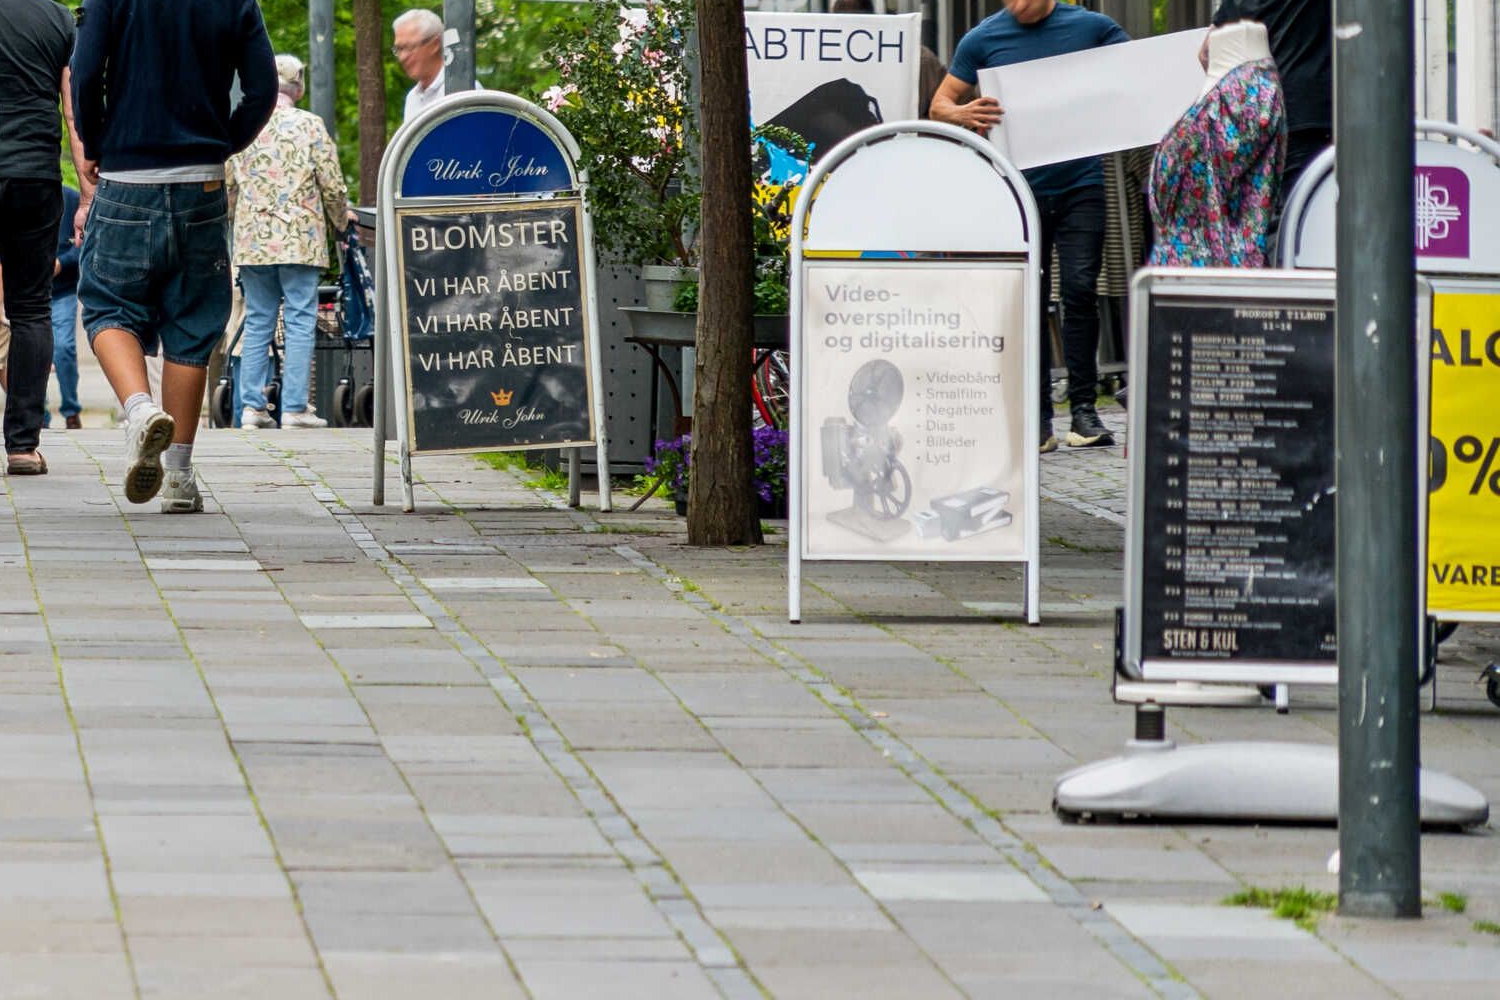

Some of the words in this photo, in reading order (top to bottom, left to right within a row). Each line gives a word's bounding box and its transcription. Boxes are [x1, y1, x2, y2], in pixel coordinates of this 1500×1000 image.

[426, 157, 484, 181] Ulrik
[488, 154, 550, 187] John
[410, 220, 570, 252] BLOMSTER
[414, 278, 437, 298] VI
[444, 275, 491, 296] HAR
[497, 269, 573, 293] ÅBENT
[825, 283, 901, 302] Video-
[416, 315, 439, 335] VI
[446, 312, 492, 333] HAR
[499, 306, 575, 330] ÅBENT
[825, 308, 961, 330] overspilning
[824, 335, 853, 353] og
[859, 331, 1005, 353] digitalisering
[418, 352, 441, 372] VI
[448, 349, 496, 371] HAR
[502, 343, 577, 368] ÅBENT
[925, 371, 1001, 384] Videobånd
[925, 387, 987, 400] Smalfilm
[458, 408, 500, 425] Ulrik
[502, 406, 547, 430] John
[925, 404, 994, 418] Negativer
[925, 420, 955, 432] Dias
[925, 436, 978, 448] Billeder
[925, 452, 951, 465] Lyd
[1163, 630, 1197, 650] STEN
[1213, 632, 1239, 651] KUL
